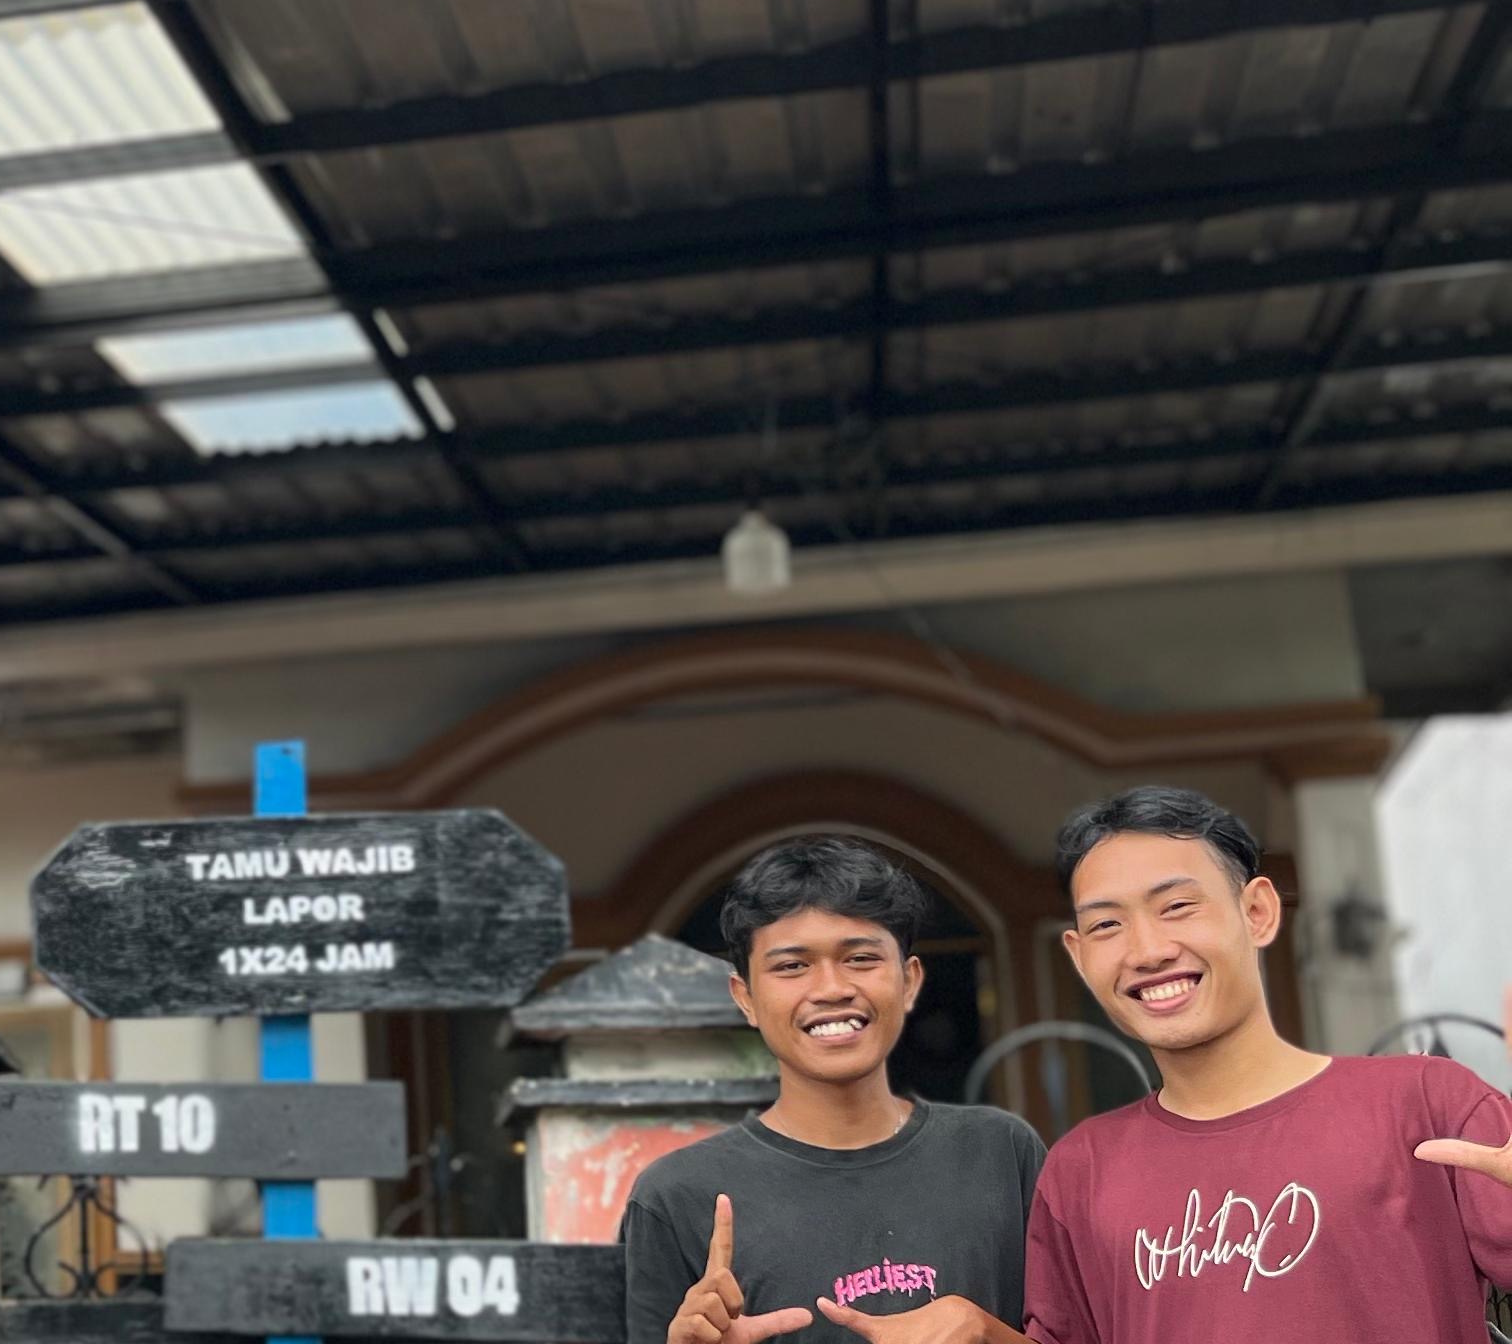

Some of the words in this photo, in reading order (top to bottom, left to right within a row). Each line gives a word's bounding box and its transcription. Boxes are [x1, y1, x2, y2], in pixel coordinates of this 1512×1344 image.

[186, 850, 290, 881] TAMU
[296, 844, 416, 876] WAJIB
[243, 893, 365, 924] LAPOR
[218, 946, 309, 976] 1X24
[316, 941, 395, 972] JAM
[78, 1092, 147, 1153] RT
[152, 1093, 216, 1154] 10
[347, 1257, 439, 1316] RW
[447, 1255, 520, 1317] 04
